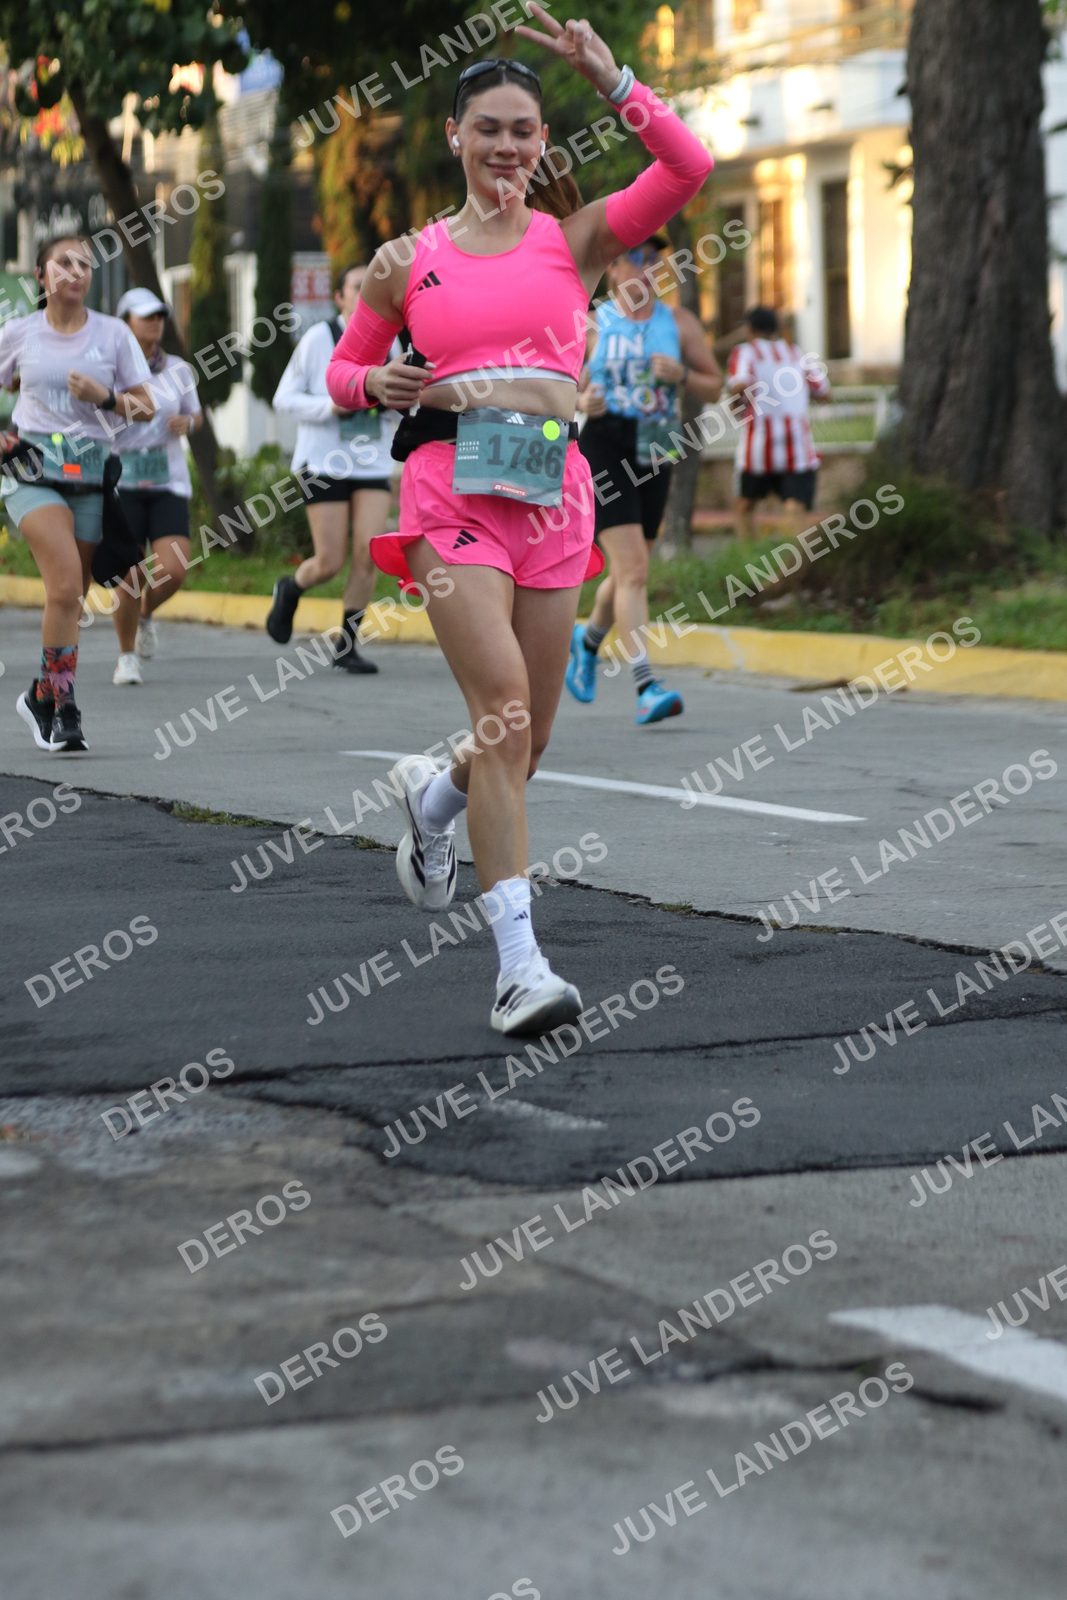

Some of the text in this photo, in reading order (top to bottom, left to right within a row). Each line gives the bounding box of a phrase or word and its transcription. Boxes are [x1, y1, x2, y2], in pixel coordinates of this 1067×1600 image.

[607, 333, 645, 360] IN
[605, 360, 656, 385] TE
[486, 433, 563, 479] 1786
